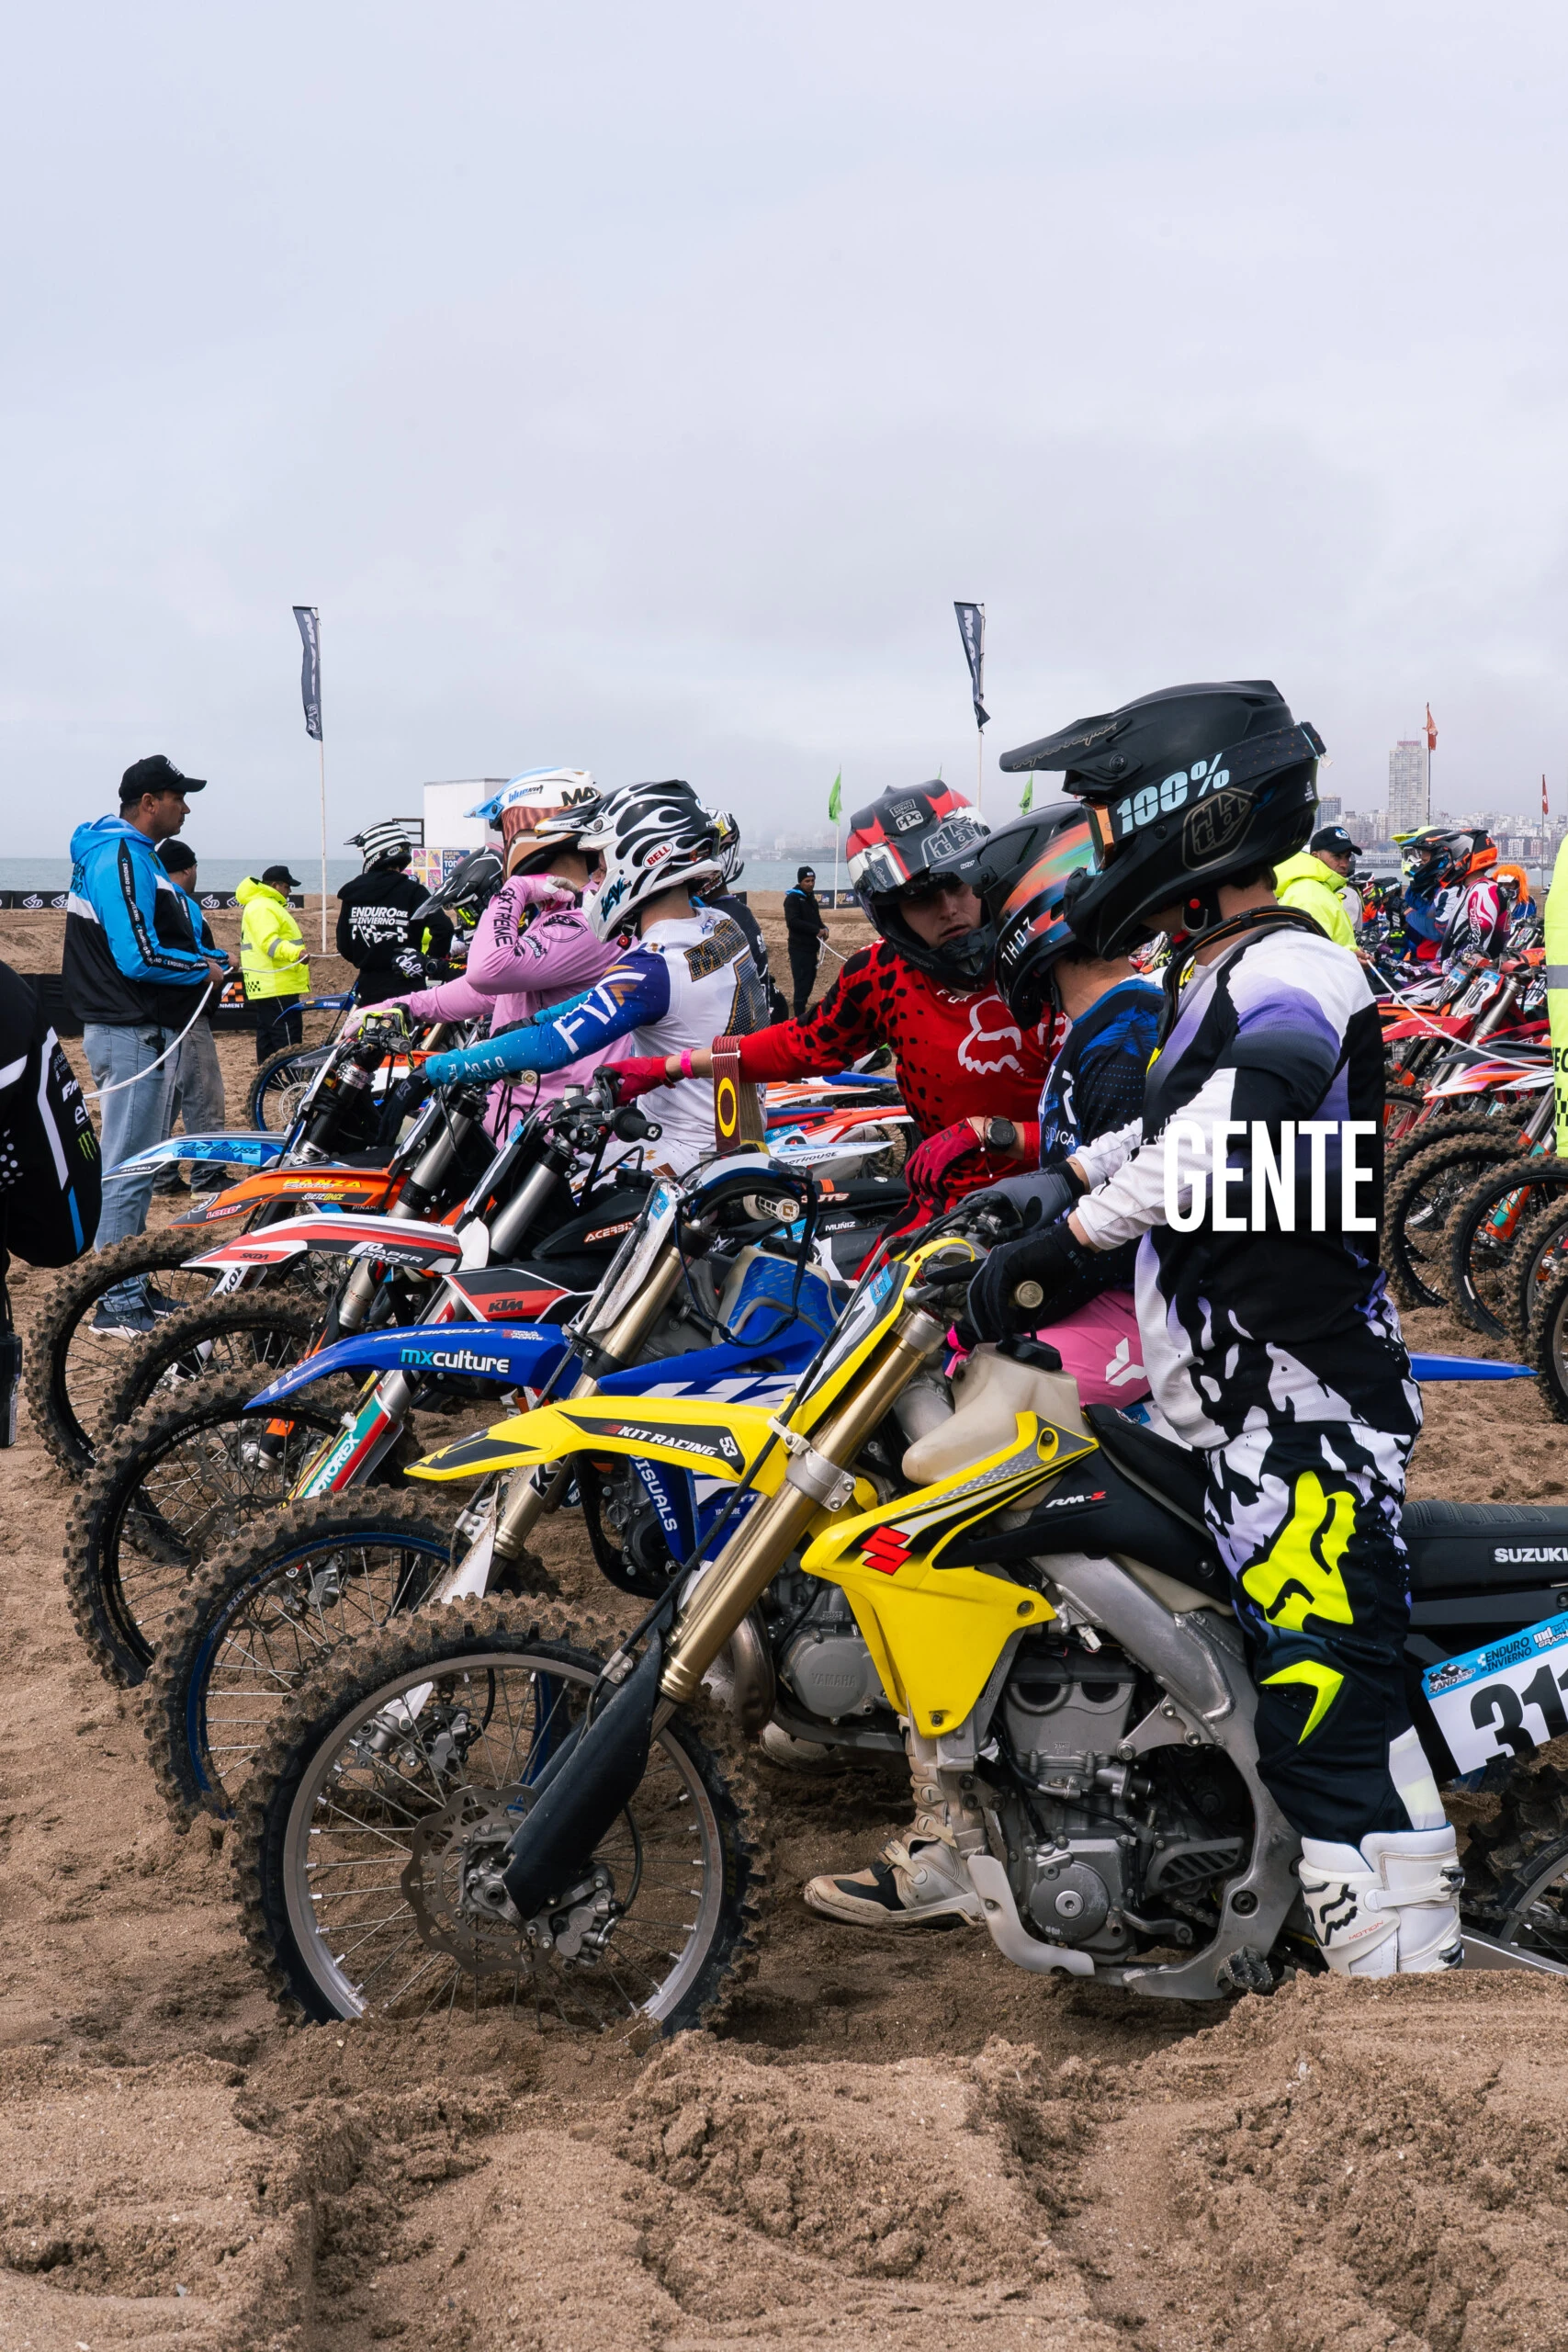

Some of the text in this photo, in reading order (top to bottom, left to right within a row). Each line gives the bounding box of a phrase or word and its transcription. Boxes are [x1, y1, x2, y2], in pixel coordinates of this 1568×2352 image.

[1117, 752, 1229, 834] 100%
[897, 813, 922, 829] PPG
[647, 845, 671, 865] BELL
[351, 907, 408, 918] ENDURO DEL
[357, 917, 396, 925] INVIERNO
[395, 954, 423, 978] deft
[177, 1145, 262, 1155] FASTHOUSE
[784, 1151, 840, 1167] STHOUSE
[301, 1193, 346, 1201] SIETEONCE
[206, 1206, 237, 1219] LORD
[584, 1220, 634, 1243] ACERBI
[825, 1221, 856, 1232] MUÑIZ
[361, 1250, 400, 1263] PRO
[488, 1298, 524, 1313] KTM
[400, 1349, 510, 1374] mxculture
[172, 1423, 200, 1442] EXCEL
[618, 1426, 739, 1458] KIT RACING 53
[1045, 1491, 1106, 1509] RM-Z
[1484, 1636, 1529, 1663] ENDURO
[1487, 1646, 1532, 1672] INVIERNO
[811, 1672, 857, 1687] YAMAHA
[1429, 1677, 1458, 1694] SAND
[1348, 1919, 1384, 1941] MOTION
